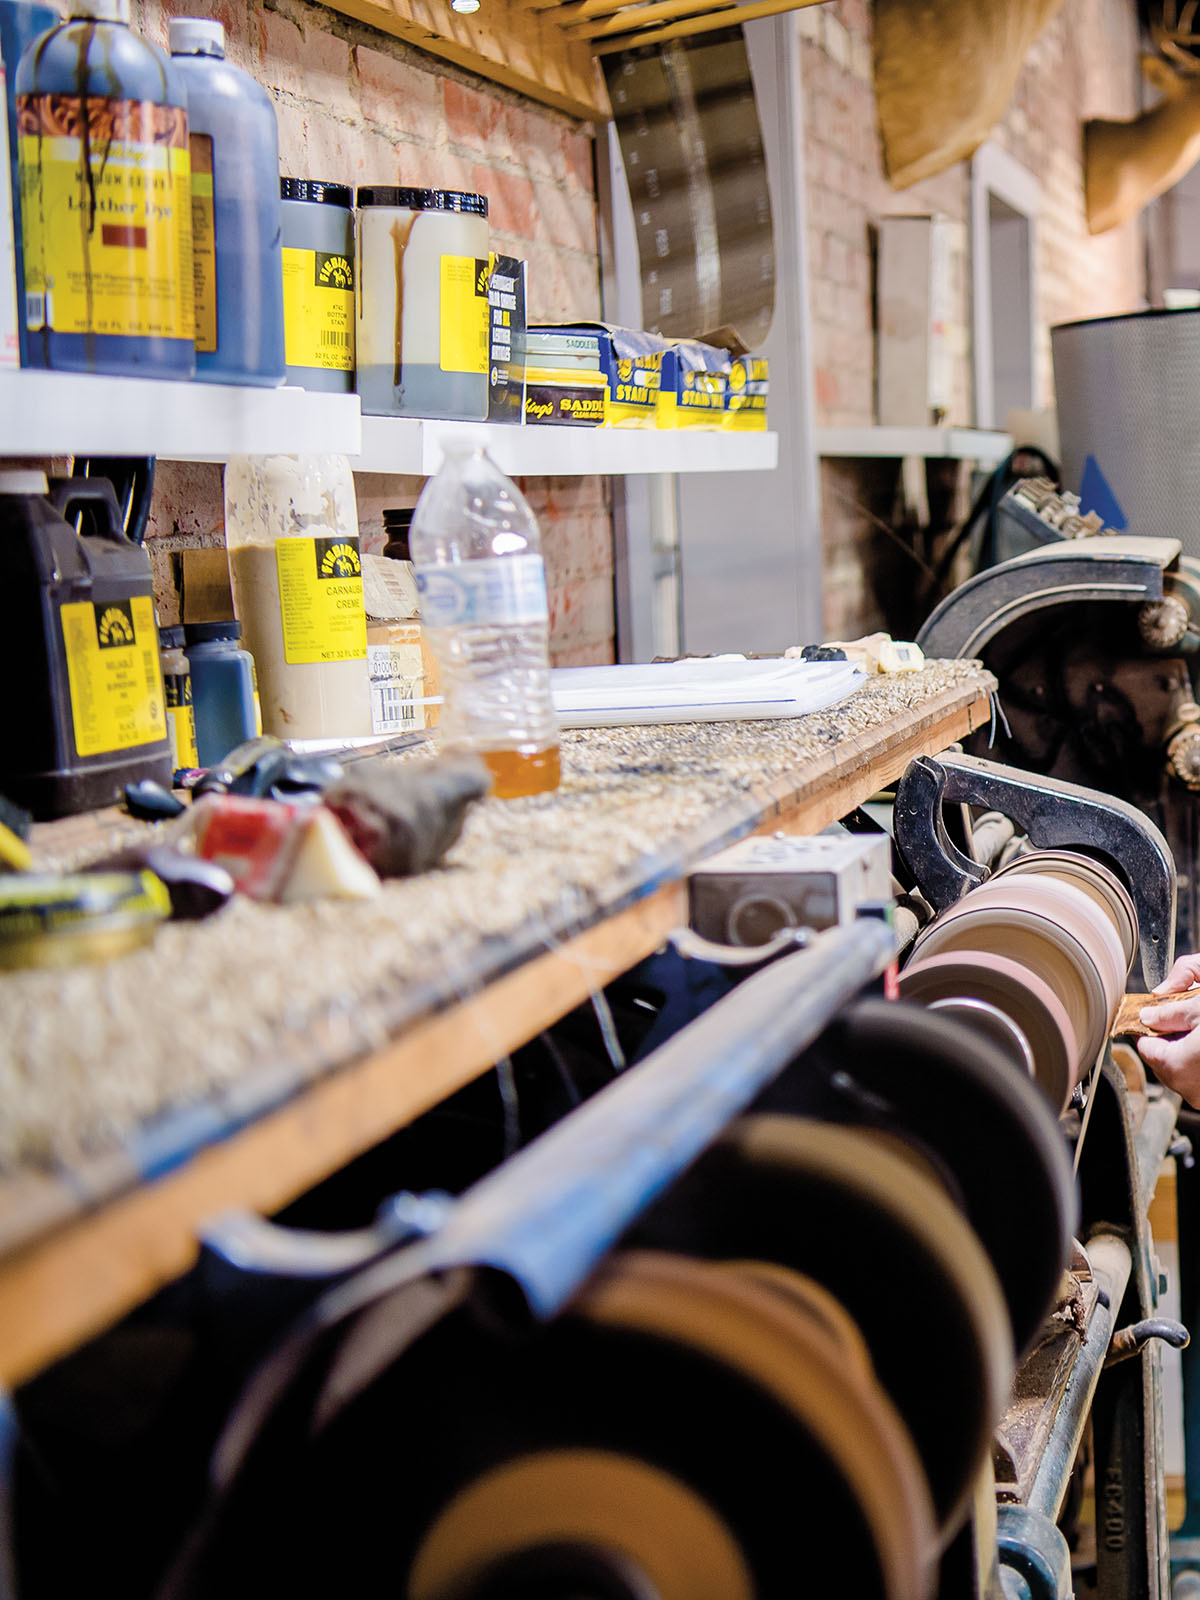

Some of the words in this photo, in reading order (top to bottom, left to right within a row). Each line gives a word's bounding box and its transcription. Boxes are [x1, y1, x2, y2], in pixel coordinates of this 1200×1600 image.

[68, 195, 138, 214] Lether
[560, 399, 604, 412] SADDL
[326, 585, 362, 596] CARNAUB
[336, 599, 360, 609] CREME
[321, 651, 335, 659] NET
